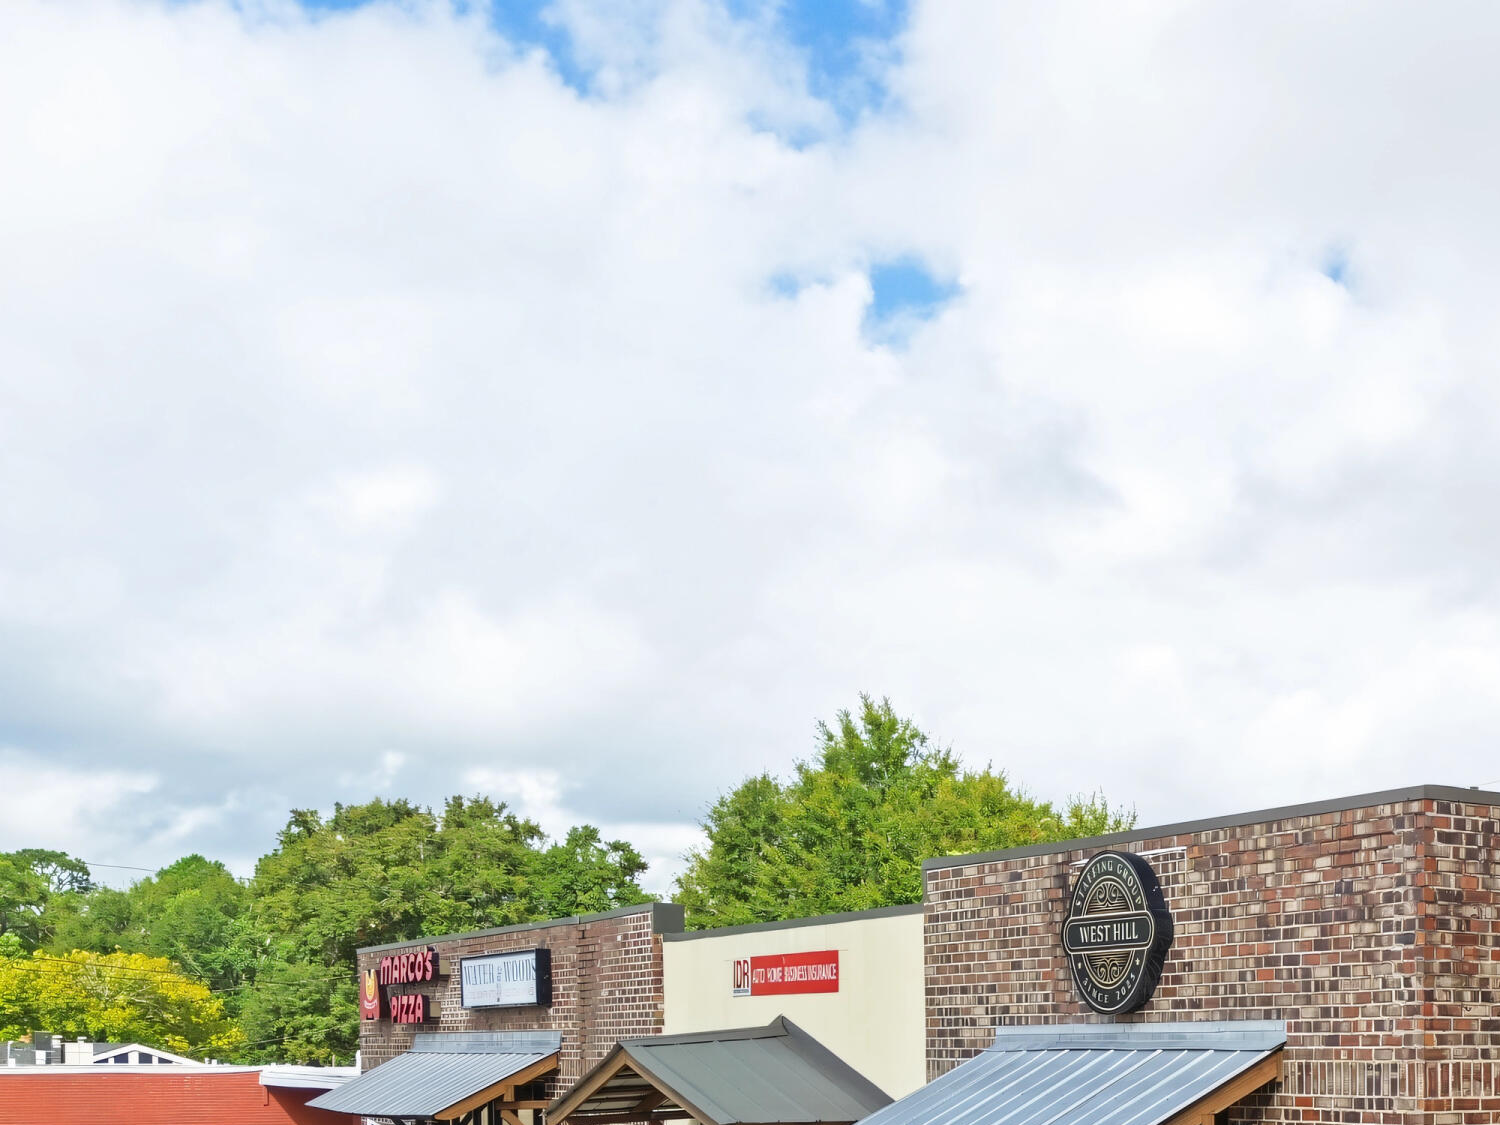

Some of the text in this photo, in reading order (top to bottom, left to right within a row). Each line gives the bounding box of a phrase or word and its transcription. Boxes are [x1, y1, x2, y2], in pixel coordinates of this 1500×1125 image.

[1075, 860, 1142, 906] STAFFING GROUP
[1079, 921, 1139, 943] WEST HILL
[380, 945, 433, 985] MARCO'S
[733, 959, 749, 988] IDR
[808, 963, 837, 981] INSURANCE
[1082, 976, 1109, 1003] SINCE
[391, 994, 423, 1024] PIZZA
